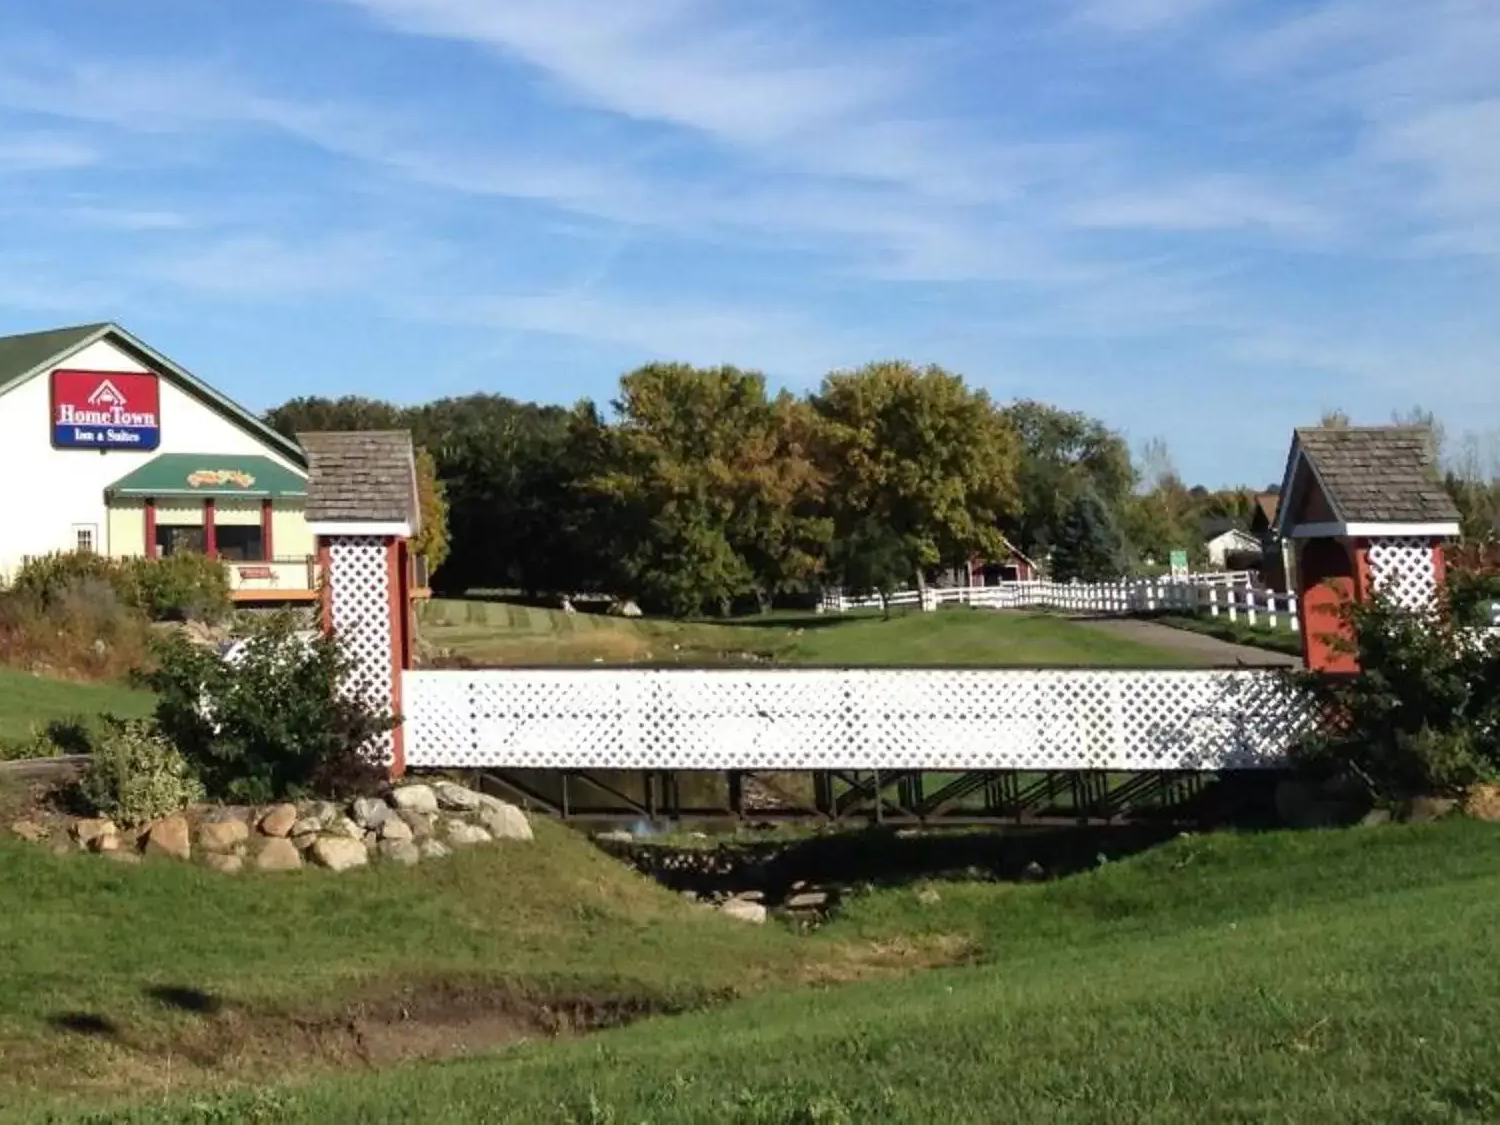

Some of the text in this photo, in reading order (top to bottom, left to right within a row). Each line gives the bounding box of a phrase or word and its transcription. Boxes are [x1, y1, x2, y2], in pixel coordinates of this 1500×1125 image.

[60, 404, 154, 426] HomeTown
[74, 428, 94, 441] Inn
[106, 428, 140, 442] Suites
